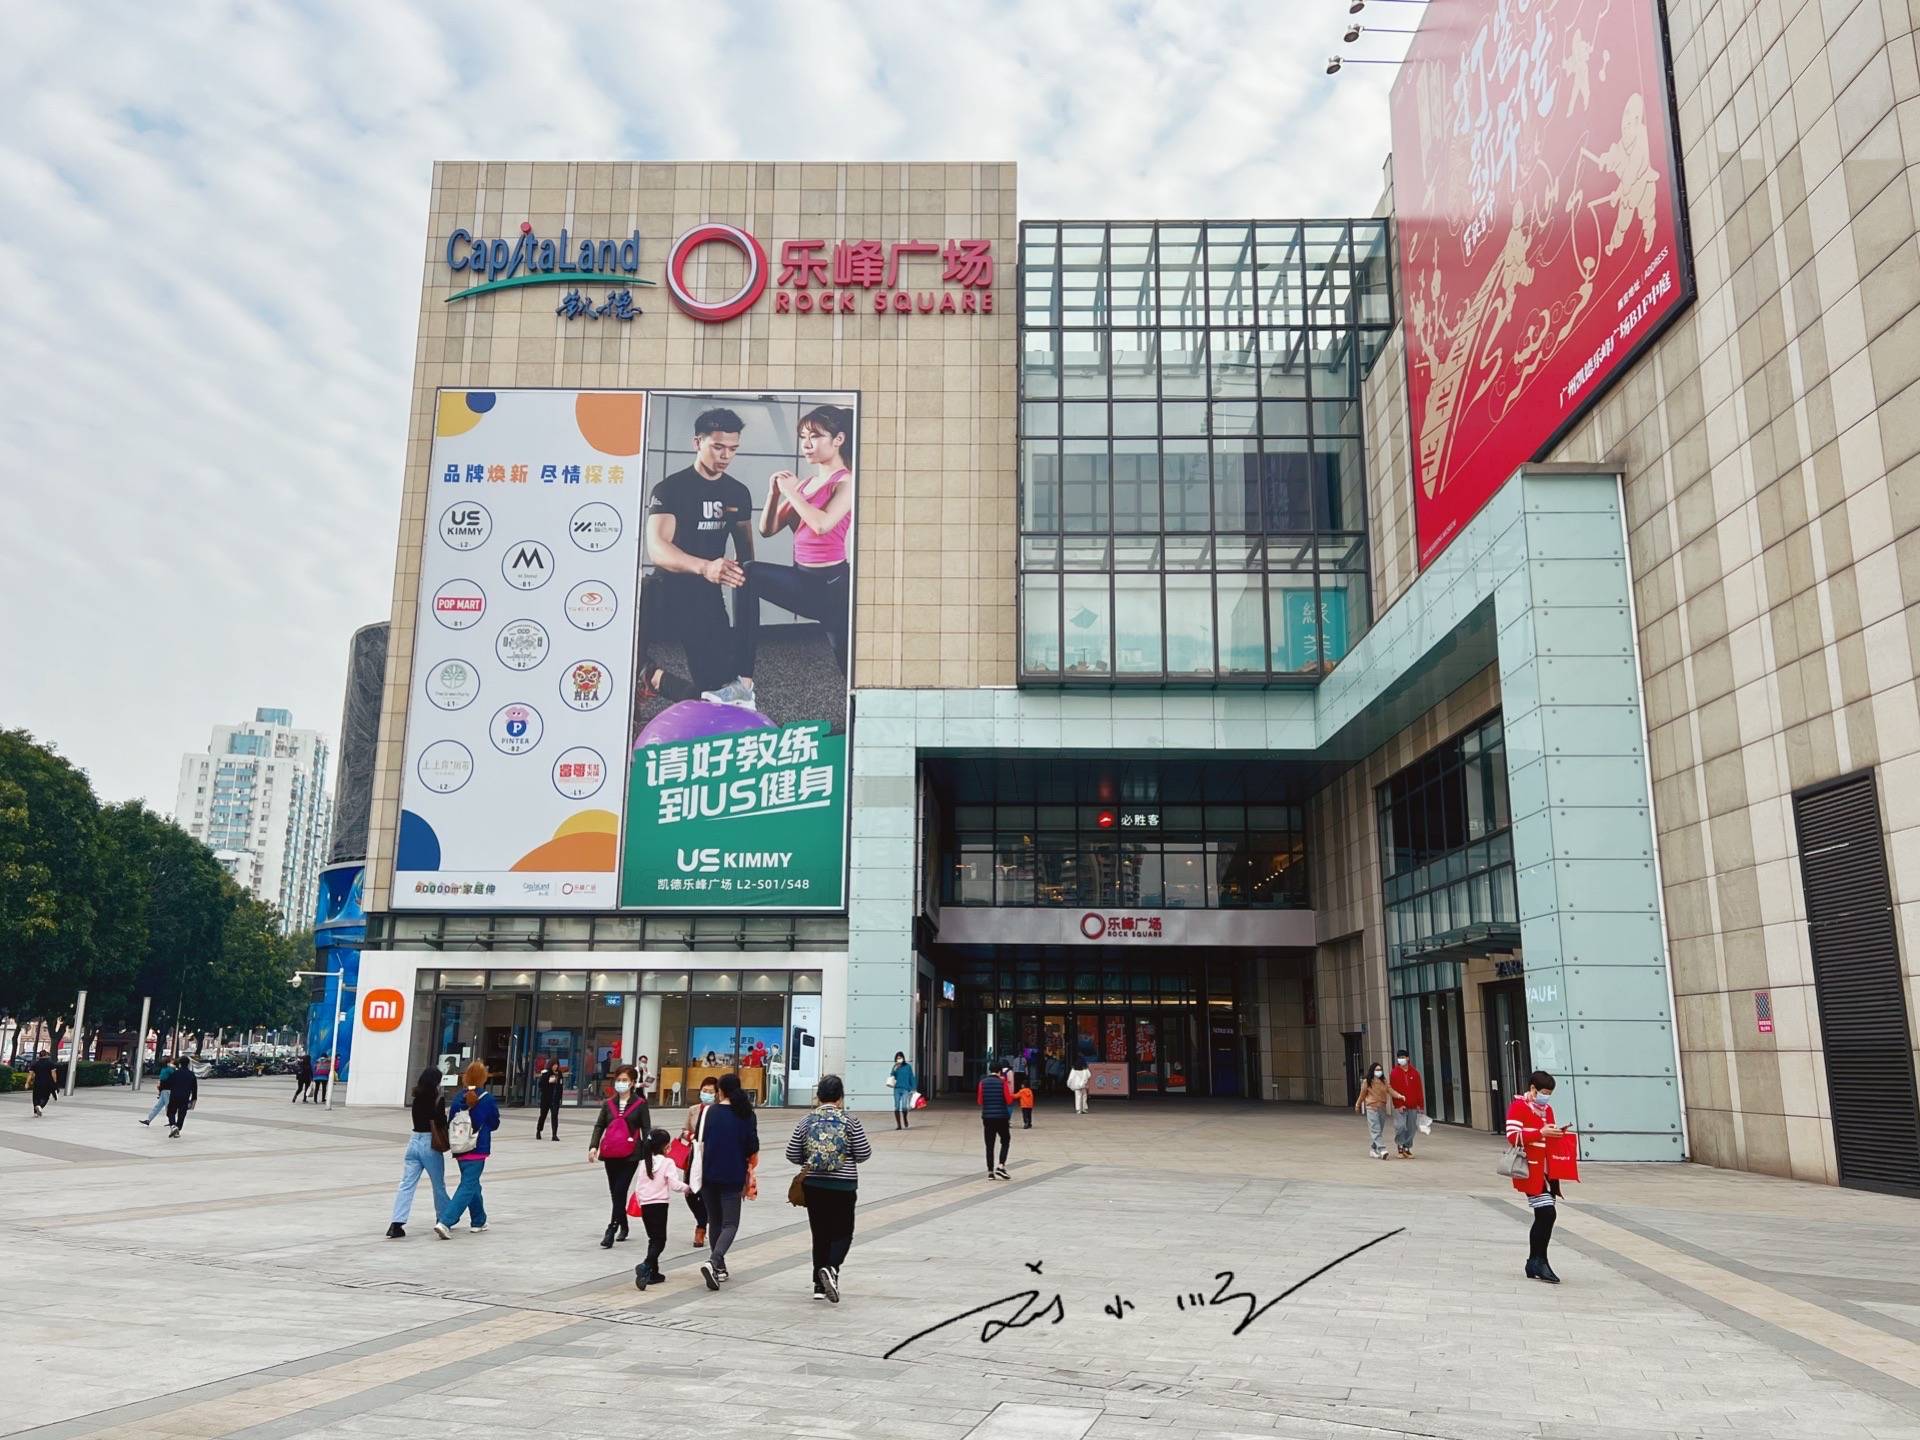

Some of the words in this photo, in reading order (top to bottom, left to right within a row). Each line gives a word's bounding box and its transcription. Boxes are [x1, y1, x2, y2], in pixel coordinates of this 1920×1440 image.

[446, 221, 640, 280] CapitaLand
[777, 239, 994, 290] 乐峰广场
[1644, 246, 1670, 281] ADDRESS
[775, 291, 856, 313] ROCK
[875, 291, 994, 313] SQUARE
[444, 464, 528, 484] 品牌焕新
[541, 465, 625, 485] 尽情探索
[452, 511, 480, 525] US
[703, 501, 724, 519] US
[447, 527, 483, 536] KIMMY
[697, 521, 726, 530] KIMMY
[438, 599, 455, 609] POP
[456, 599, 481, 610] MART
[646, 726, 819, 787] 请好教练
[658, 765, 834, 825] 到US健身
[1121, 813, 1160, 827] 必胜客
[676, 848, 721, 873] US
[723, 852, 793, 868] KIMMY
[657, 878, 733, 891] 凯德乐峰广场
[736, 879, 810, 890] L2-S01/S48
[1107, 917, 1162, 931] 乐峰广场
